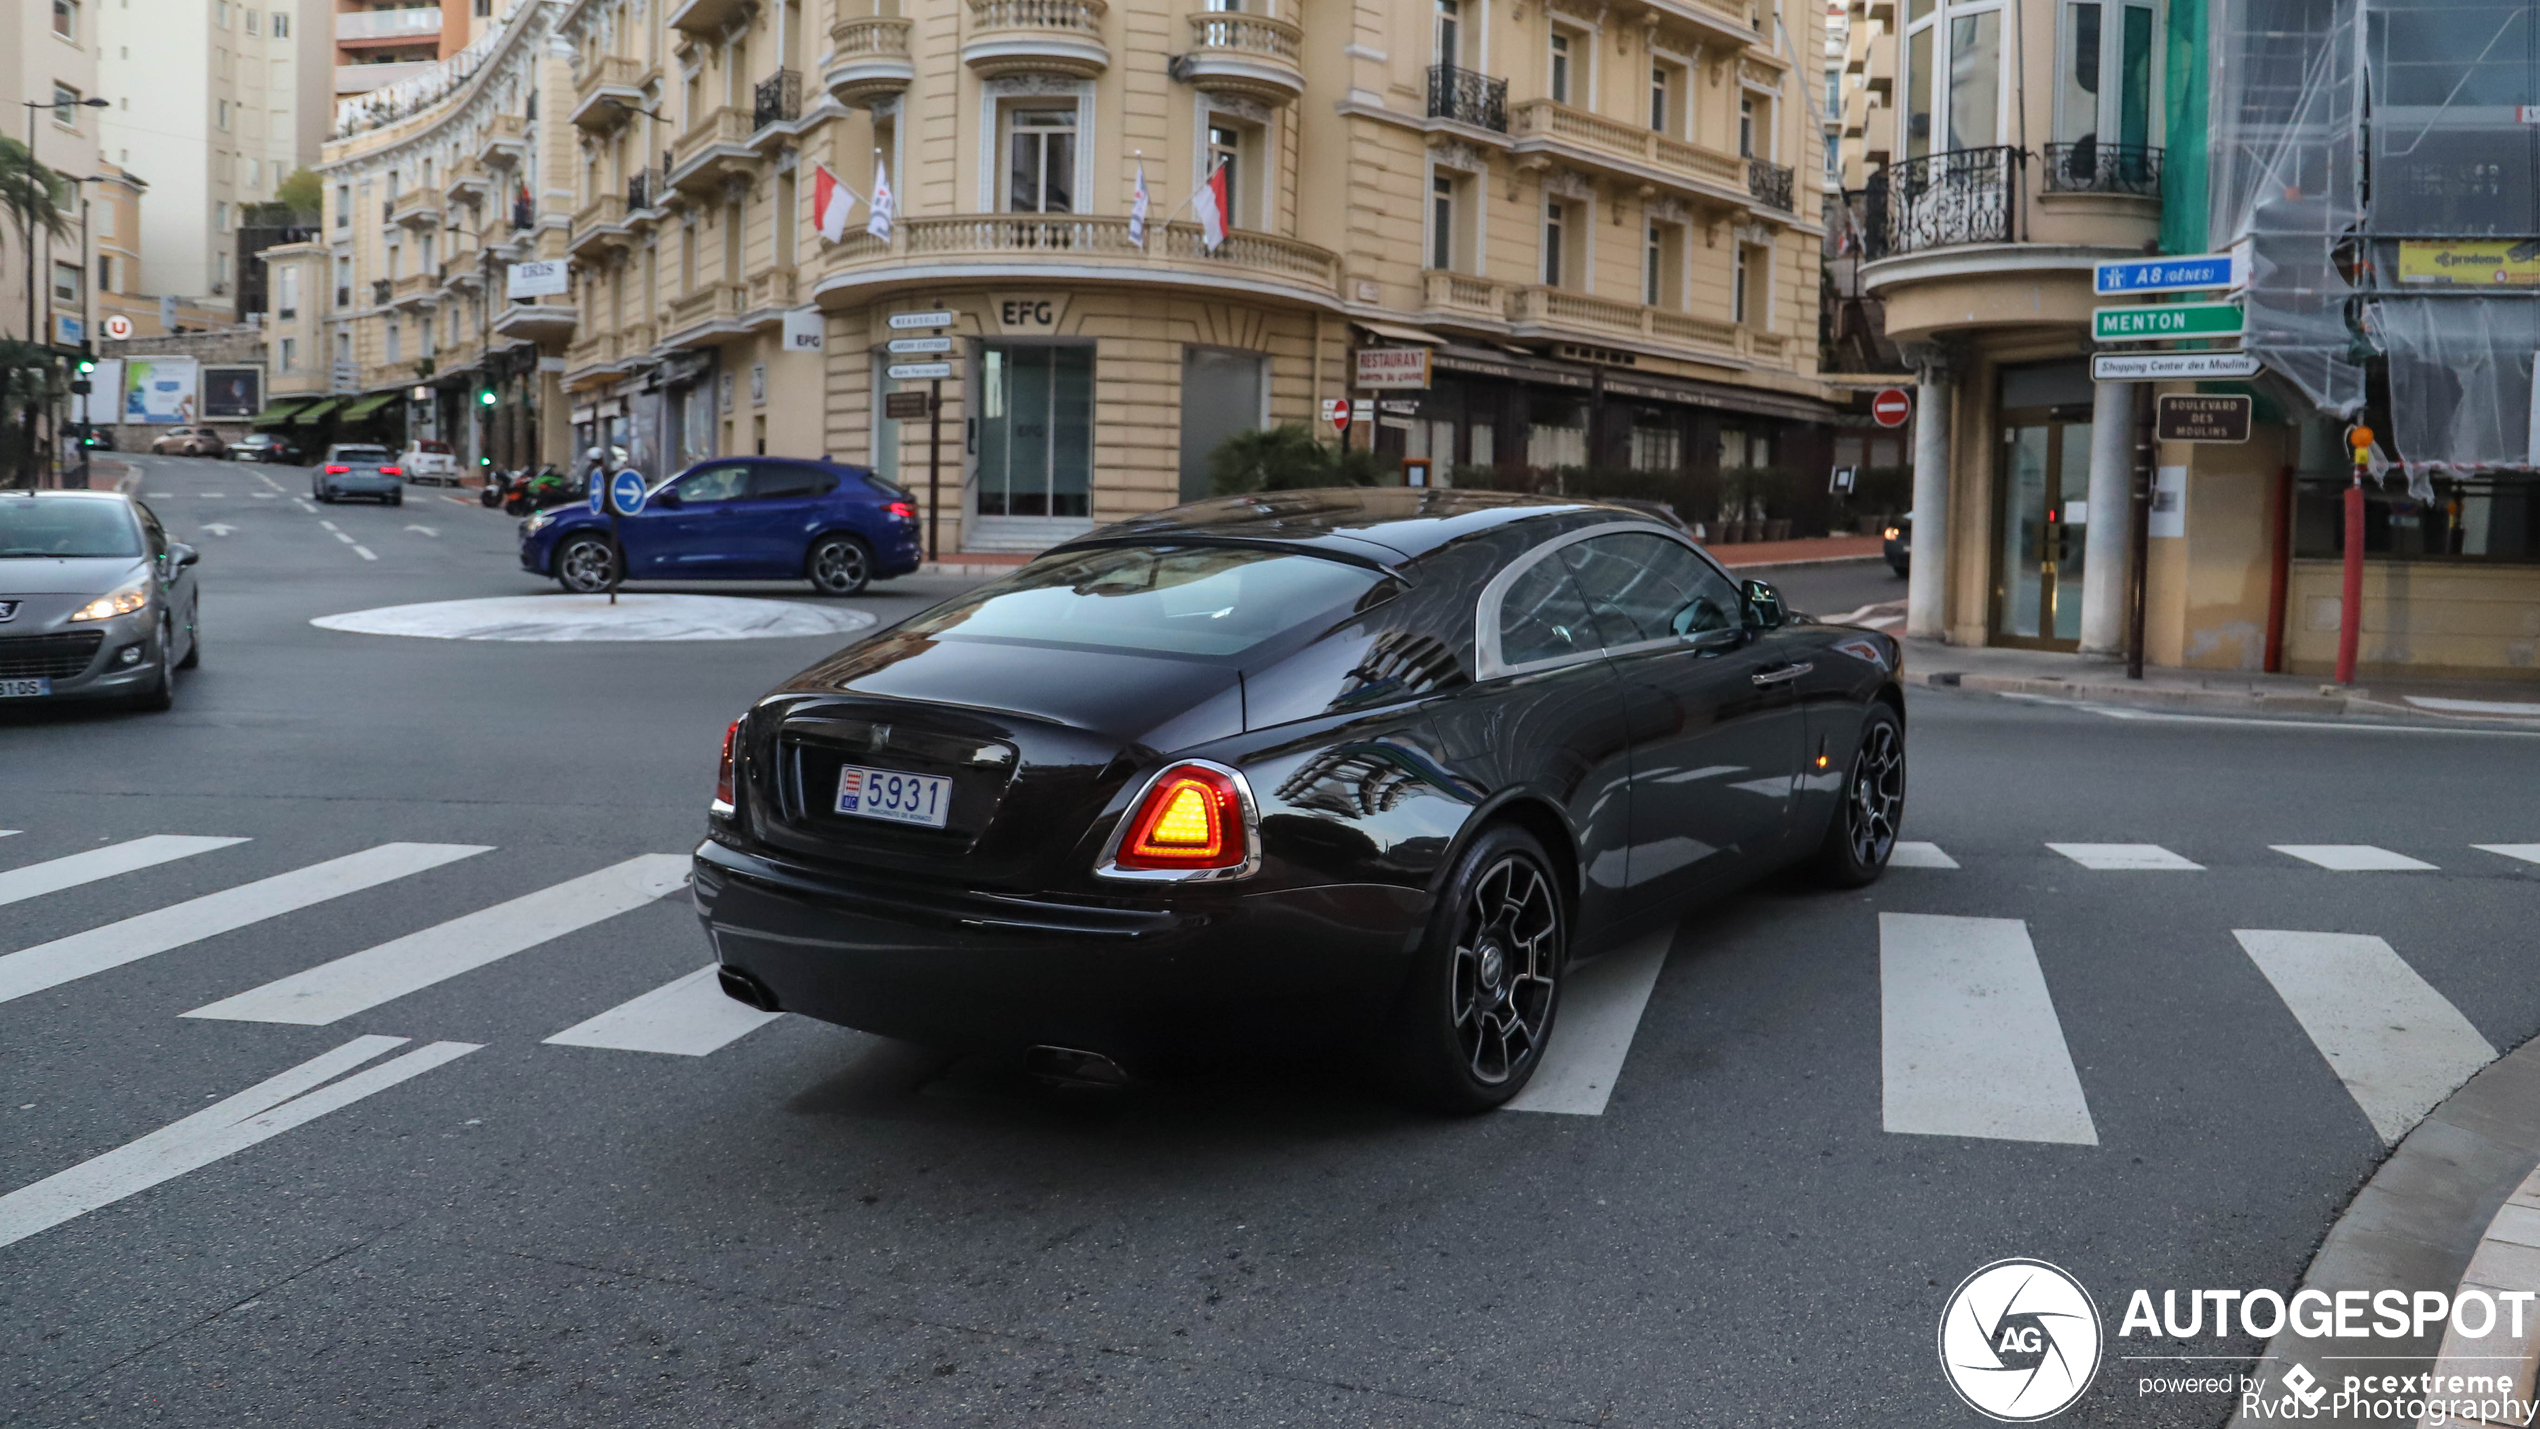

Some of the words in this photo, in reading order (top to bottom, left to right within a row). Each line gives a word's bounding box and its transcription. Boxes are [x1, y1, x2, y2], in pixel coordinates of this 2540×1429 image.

[2136, 268, 2162, 284] A8
[2165, 268, 2214, 282] (GÊNES)
[1003, 301, 1052, 325] EFG
[112, 321, 126, 334] U
[2103, 312, 2185, 331] MENTON
[796, 335, 820, 347] EFG
[1360, 352, 1424, 368] RESTAURANT
[2101, 361, 2147, 373] Shopping
[2151, 360, 2184, 370] Center
[2188, 358, 2204, 369] des
[2209, 357, 2250, 369] Moulins
[2170, 400, 2238, 411] BOULEVARD
[2191, 413, 2214, 424] DES
[2175, 426, 2228, 436] MOULINS
[867, 773, 938, 814] 5931
[844, 797, 857, 807] MC
